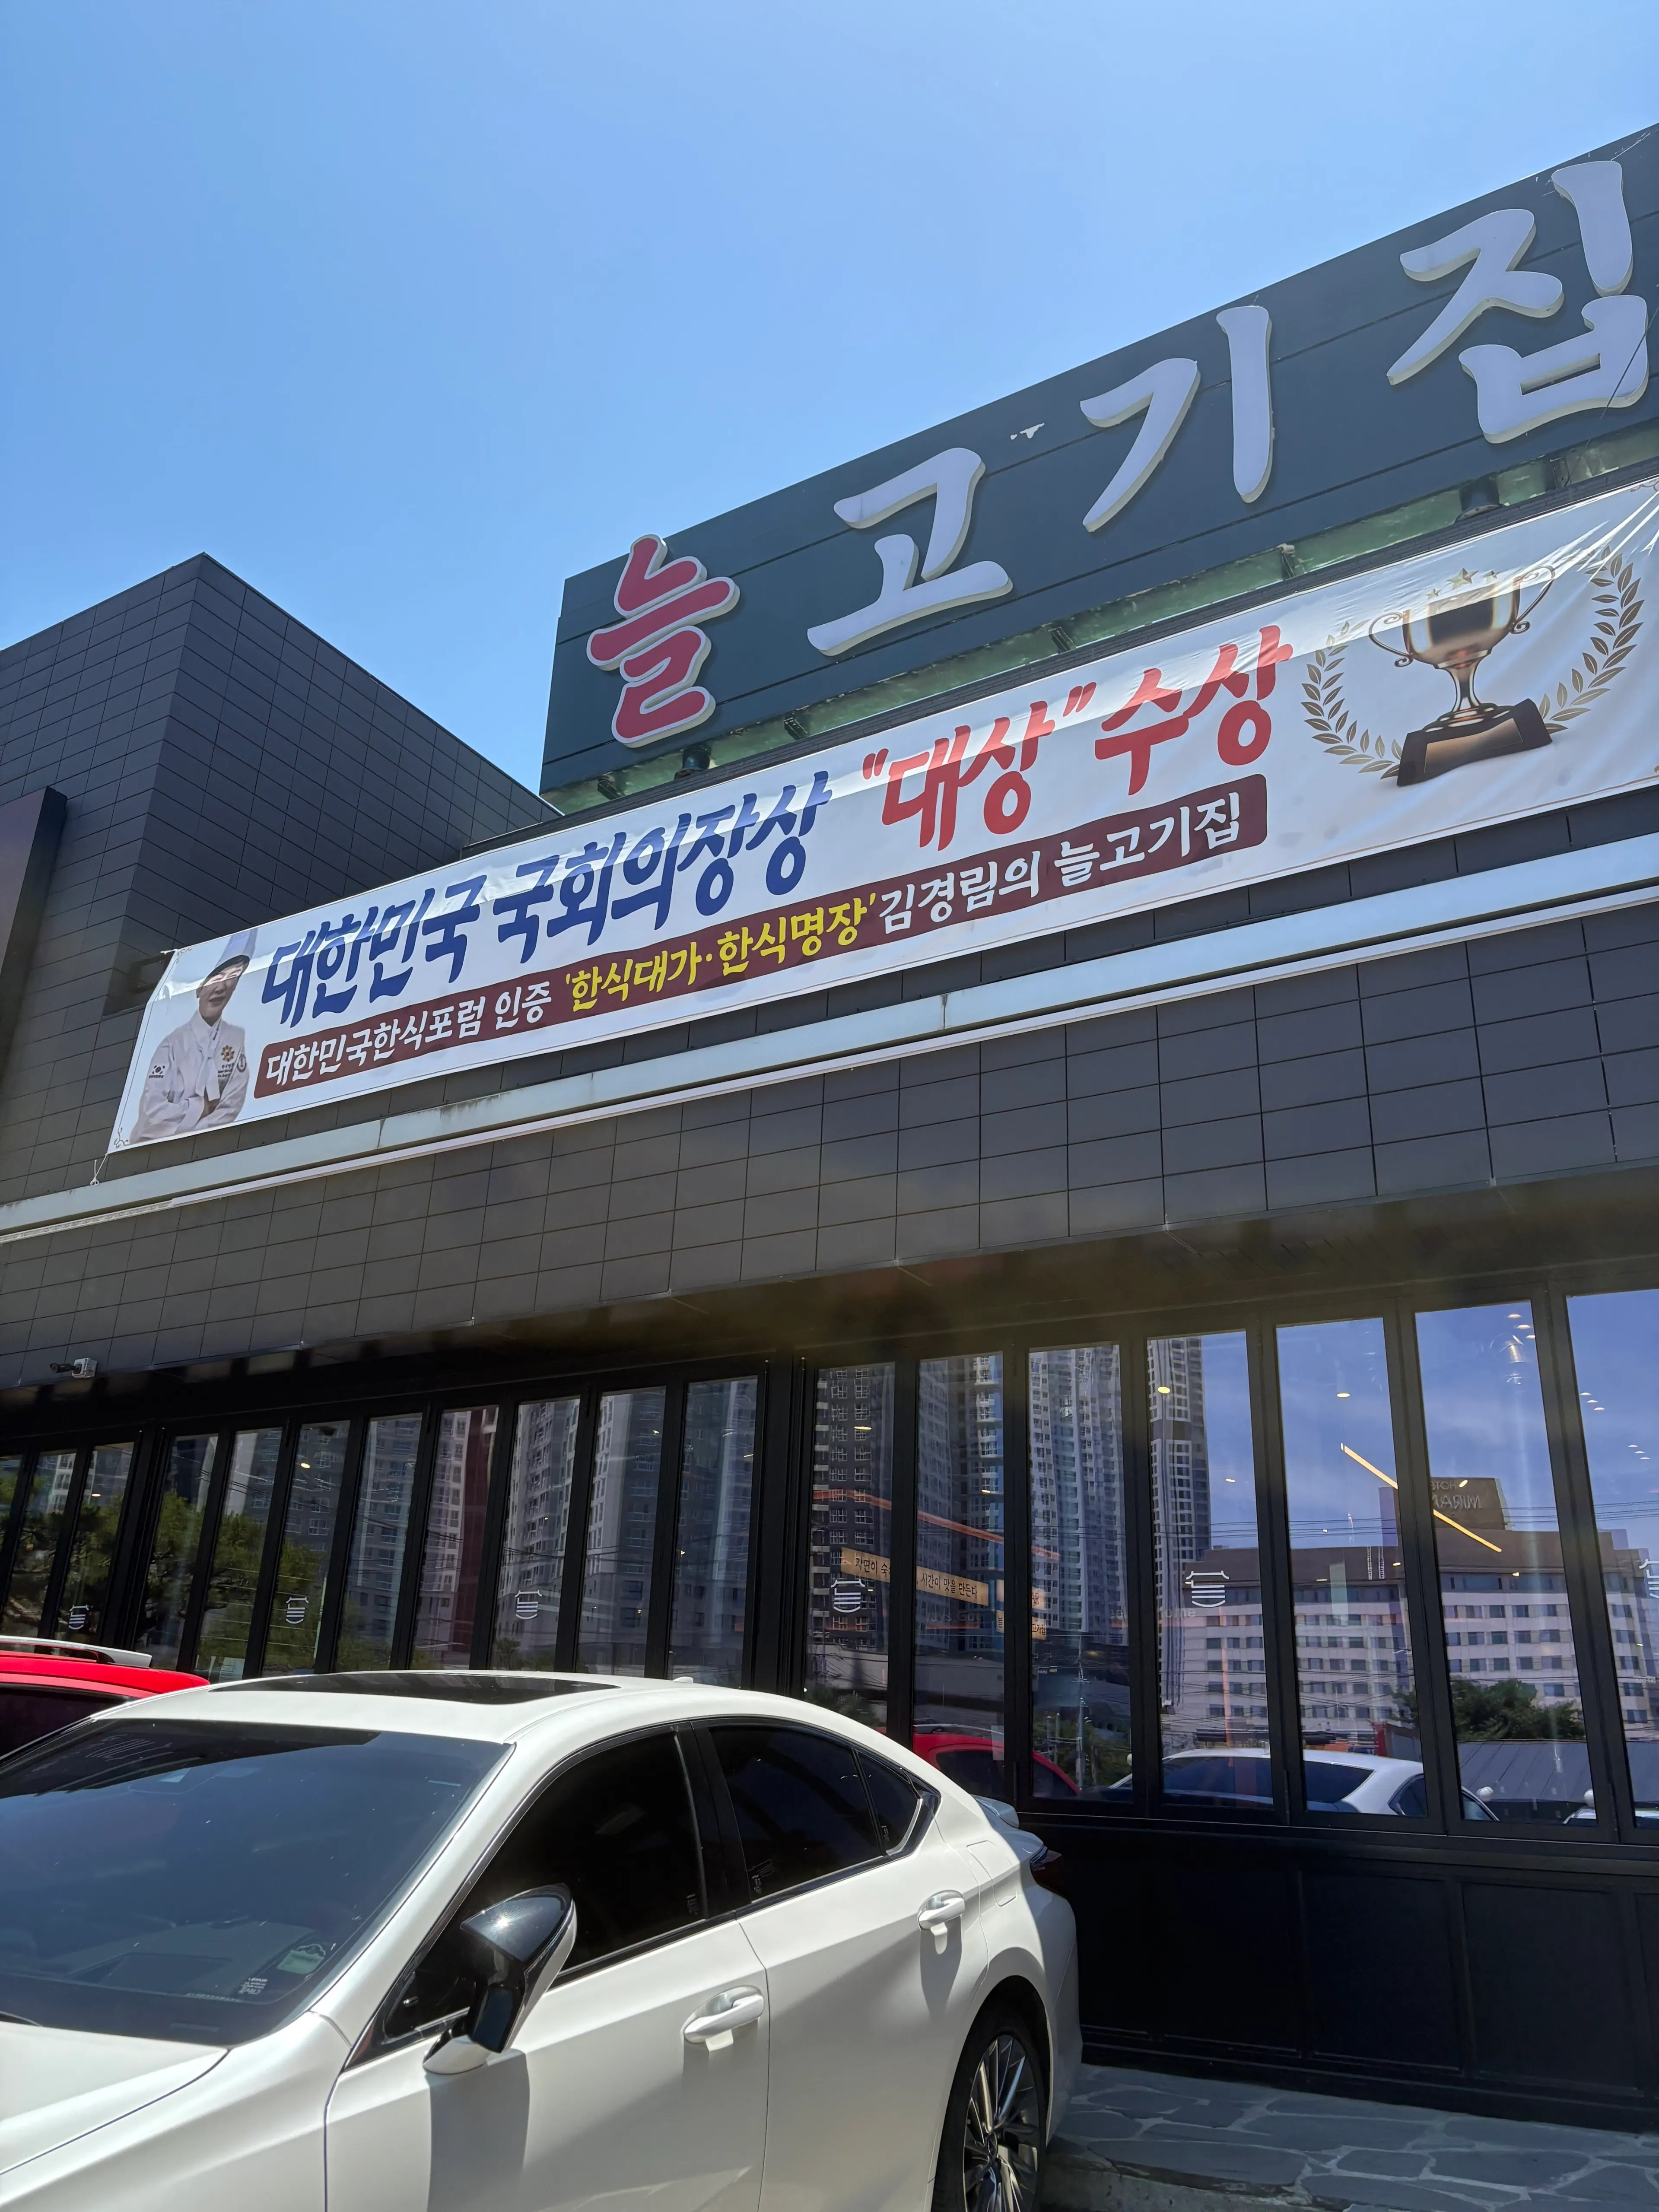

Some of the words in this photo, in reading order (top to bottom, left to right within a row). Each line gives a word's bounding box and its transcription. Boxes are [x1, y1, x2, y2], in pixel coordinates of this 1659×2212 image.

[261, 874, 487, 1028] 대한민국
[493, 770, 833, 964] 국회의장상
[862, 681, 1097, 851] "대상"
[1094, 625, 1293, 796] 수상
[267, 996, 486, 1086] 대한민국한식포럼
[495, 981, 552, 1030] 인증
[879, 850, 1041, 934] 김경림의
[1054, 792, 1240, 887] 늘고기집
[855, 1557, 878, 1574] 자연이
[921, 1573, 941, 1590] 시간이
[959, 1582, 977, 1598] 만든다
